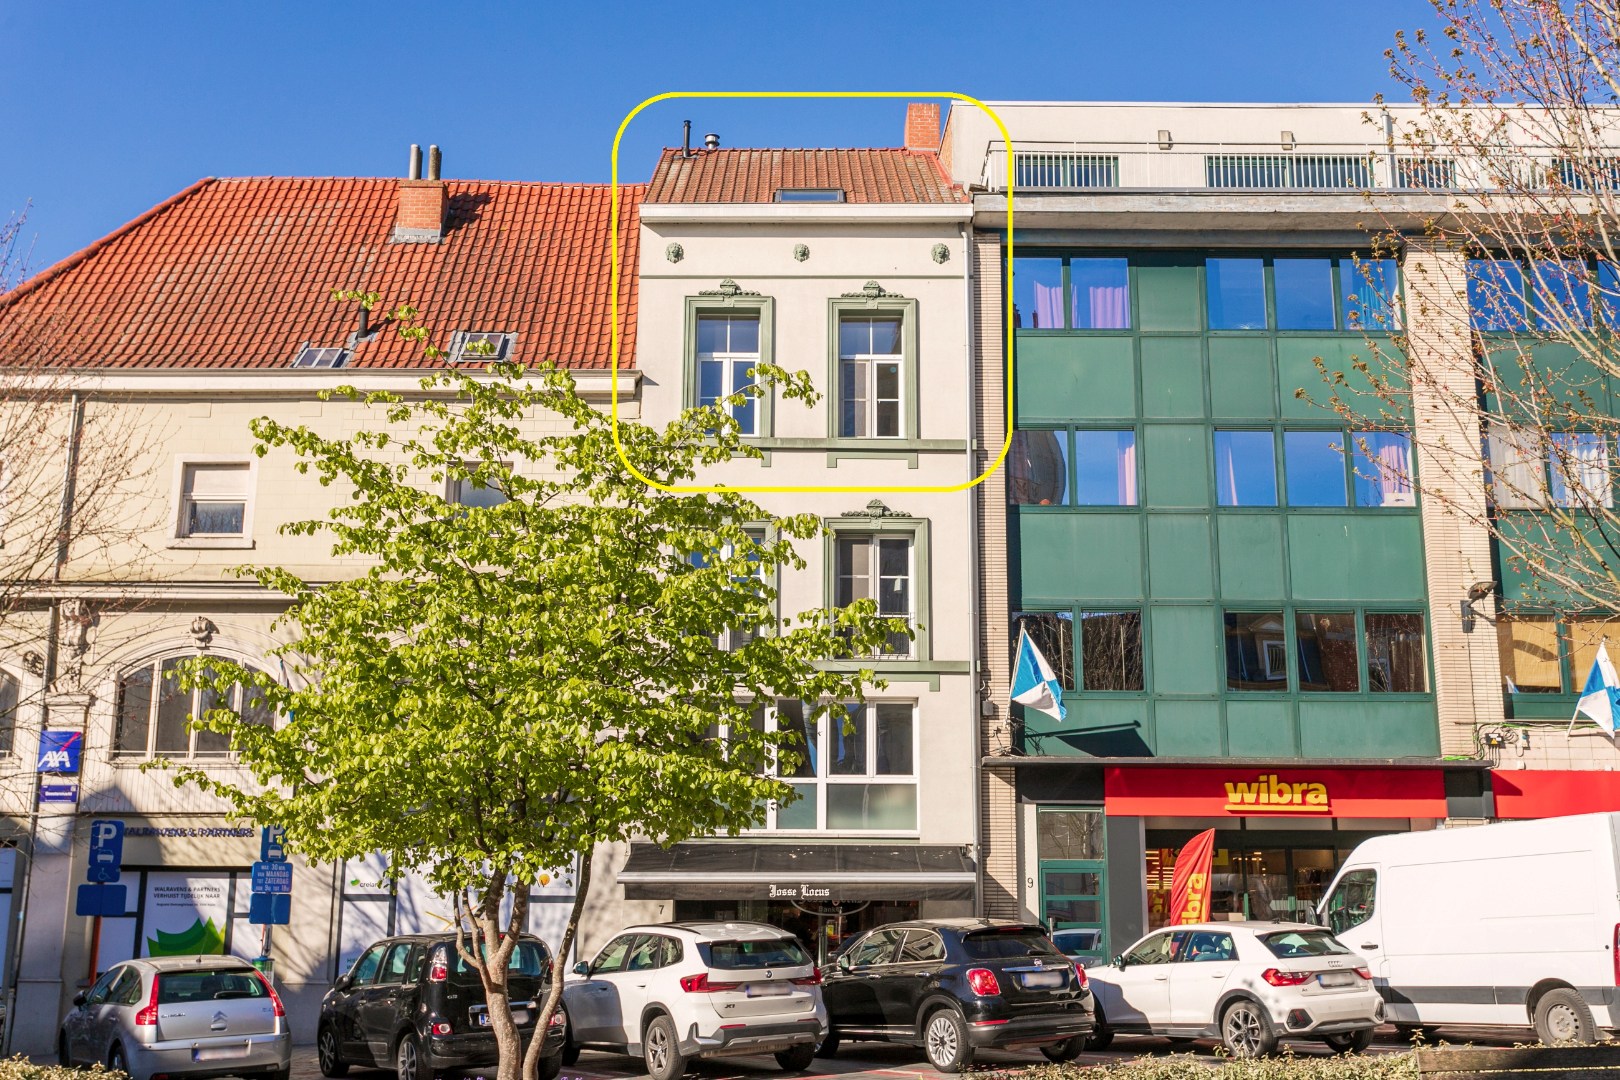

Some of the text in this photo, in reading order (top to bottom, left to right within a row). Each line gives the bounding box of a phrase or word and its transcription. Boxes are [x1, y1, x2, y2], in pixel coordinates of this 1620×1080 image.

[37, 750, 71, 768] AXA
[1224, 774, 1328, 805] wibra
[98, 823, 117, 848] P
[198, 827, 254, 837] PARTNERS
[265, 870, 290, 878] MAANDAG
[264, 877, 289, 885] ZATERDAG
[1027, 877, 1034, 889] 9
[769, 884, 830, 900] Josse Locus
[658, 904, 665, 915] 7
